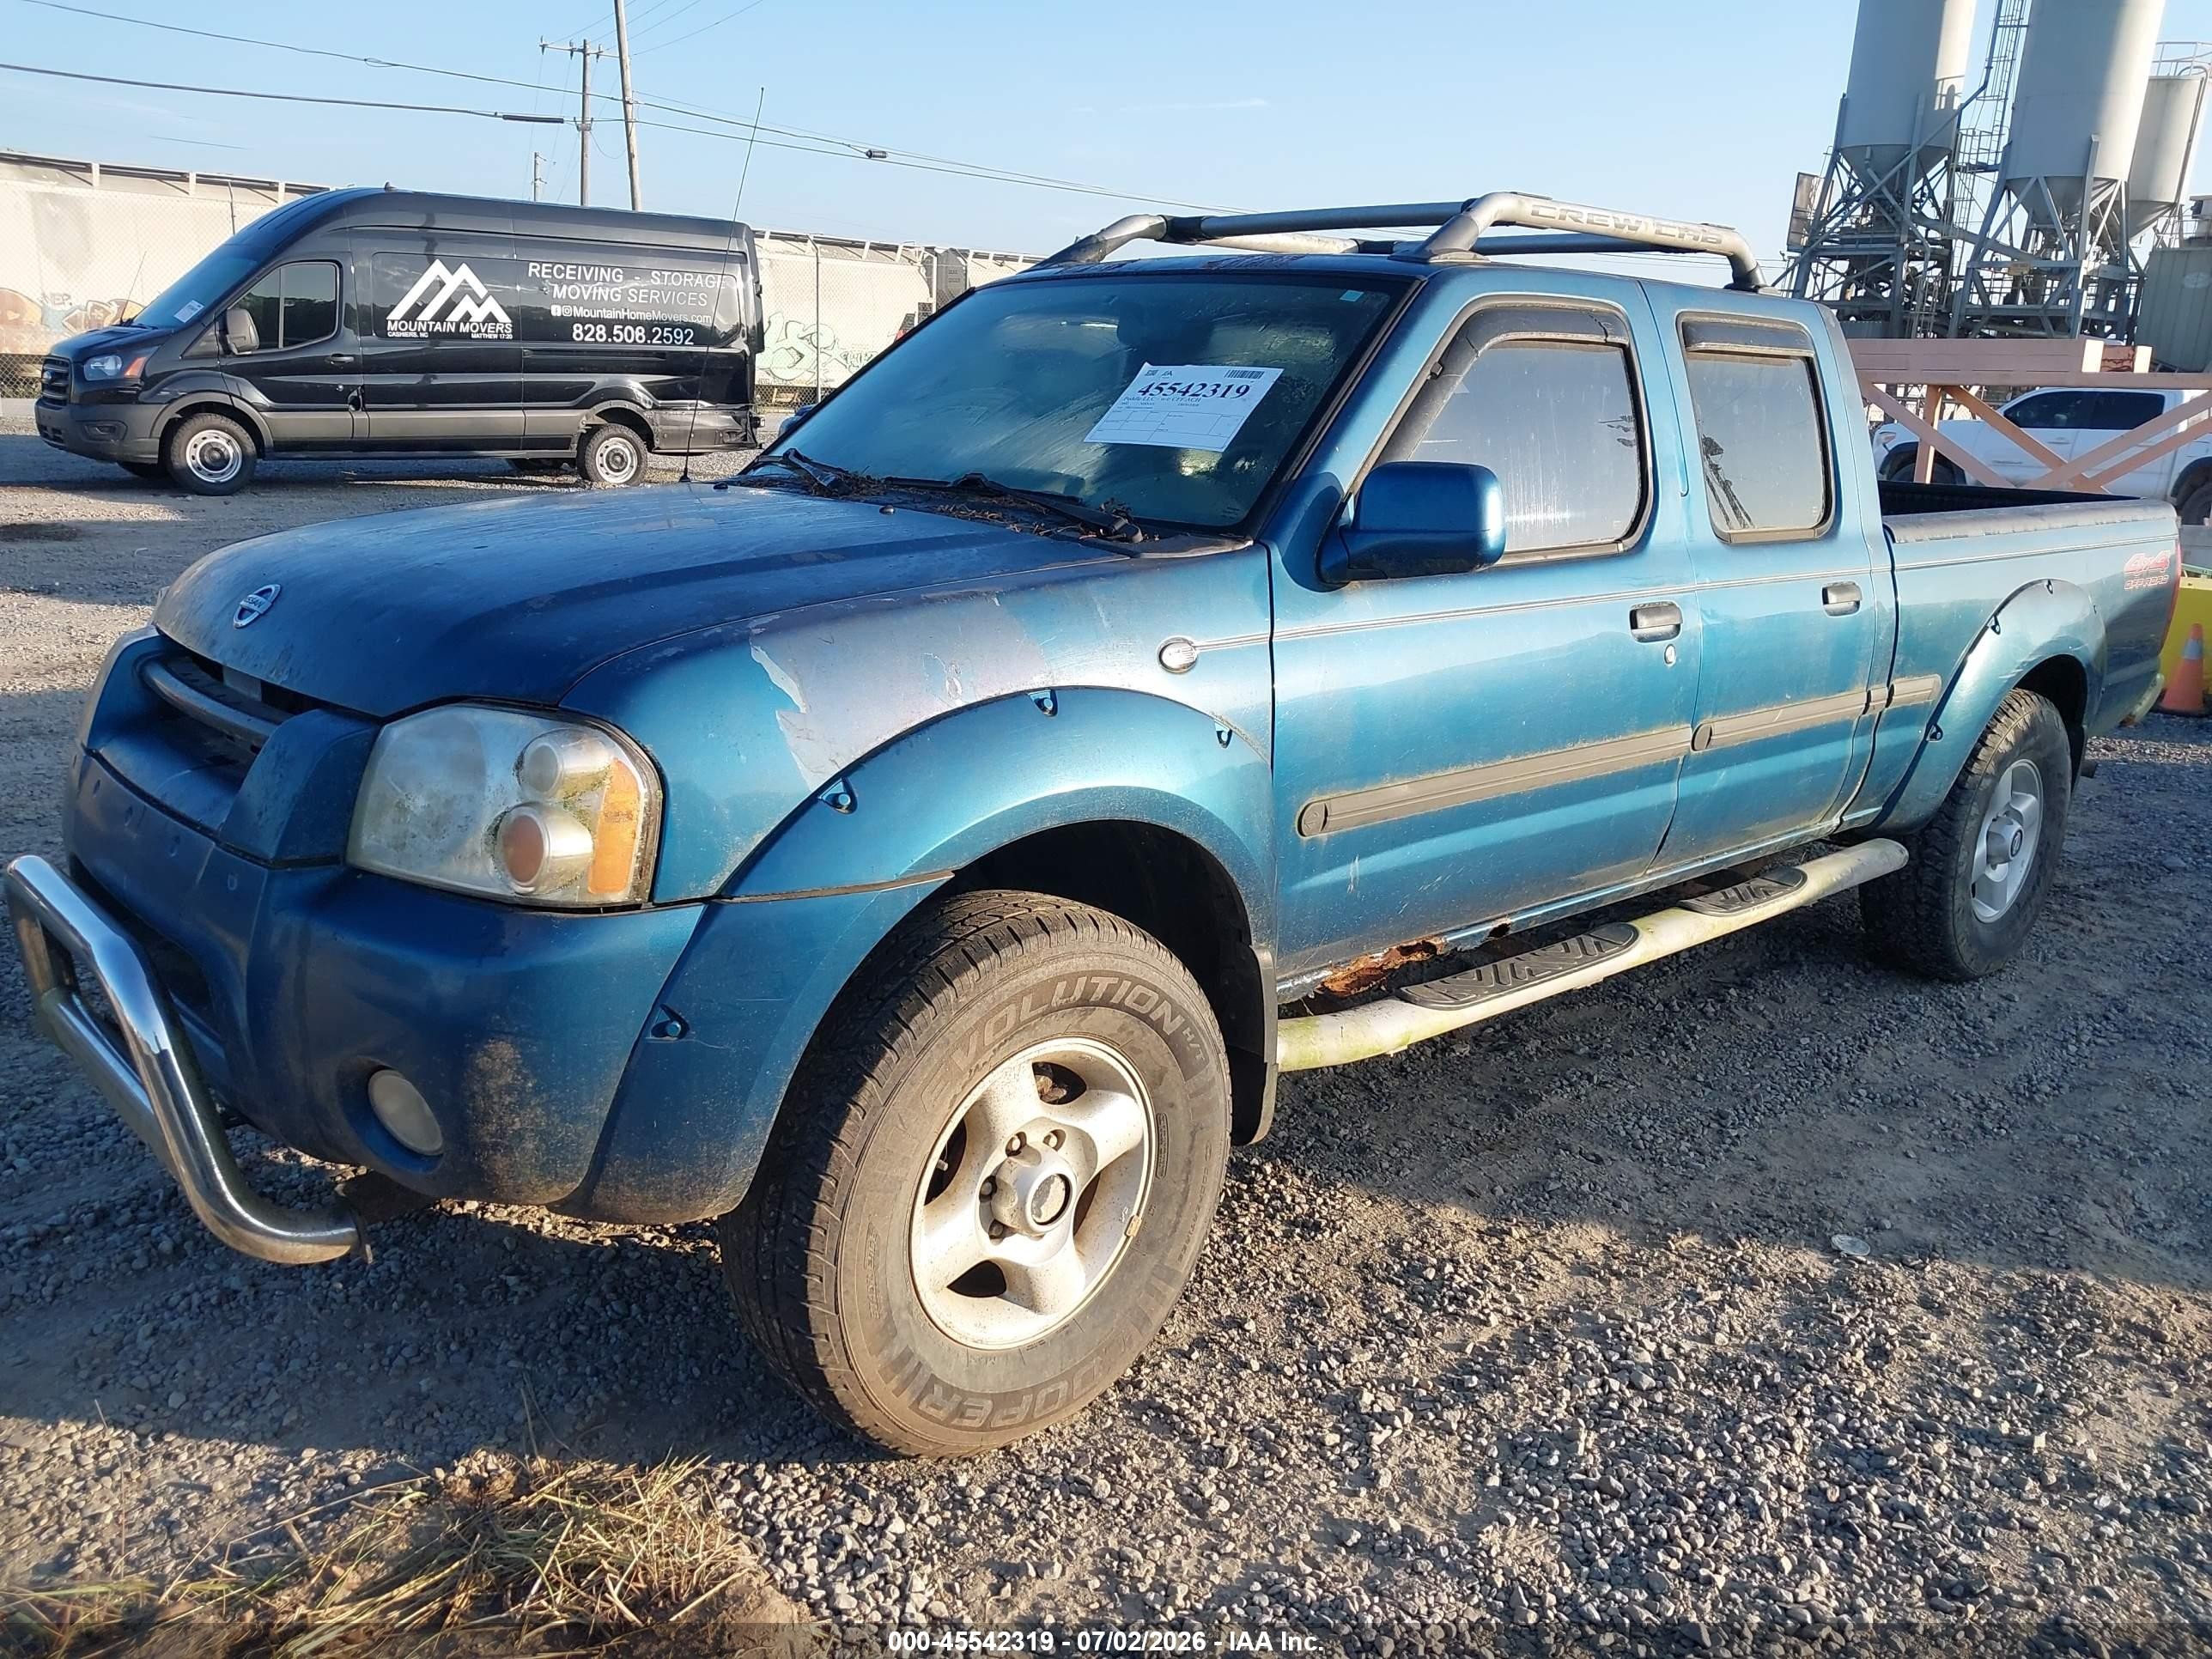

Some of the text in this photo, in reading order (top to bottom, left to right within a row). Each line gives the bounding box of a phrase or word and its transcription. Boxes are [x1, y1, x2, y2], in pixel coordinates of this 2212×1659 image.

[1530, 204, 1642, 232] CREW
[528, 262, 624, 283] RECEIVING
[650, 270, 726, 289] STORAGE
[552, 284, 708, 307] MOVING SERVICES
[573, 306, 713, 324] MountainHomeMovers.com
[386, 320, 513, 334] MOUNTAIN MOVERS
[572, 323, 695, 345] 828.508.2592
[1137, 381, 1251, 399] 45542319
